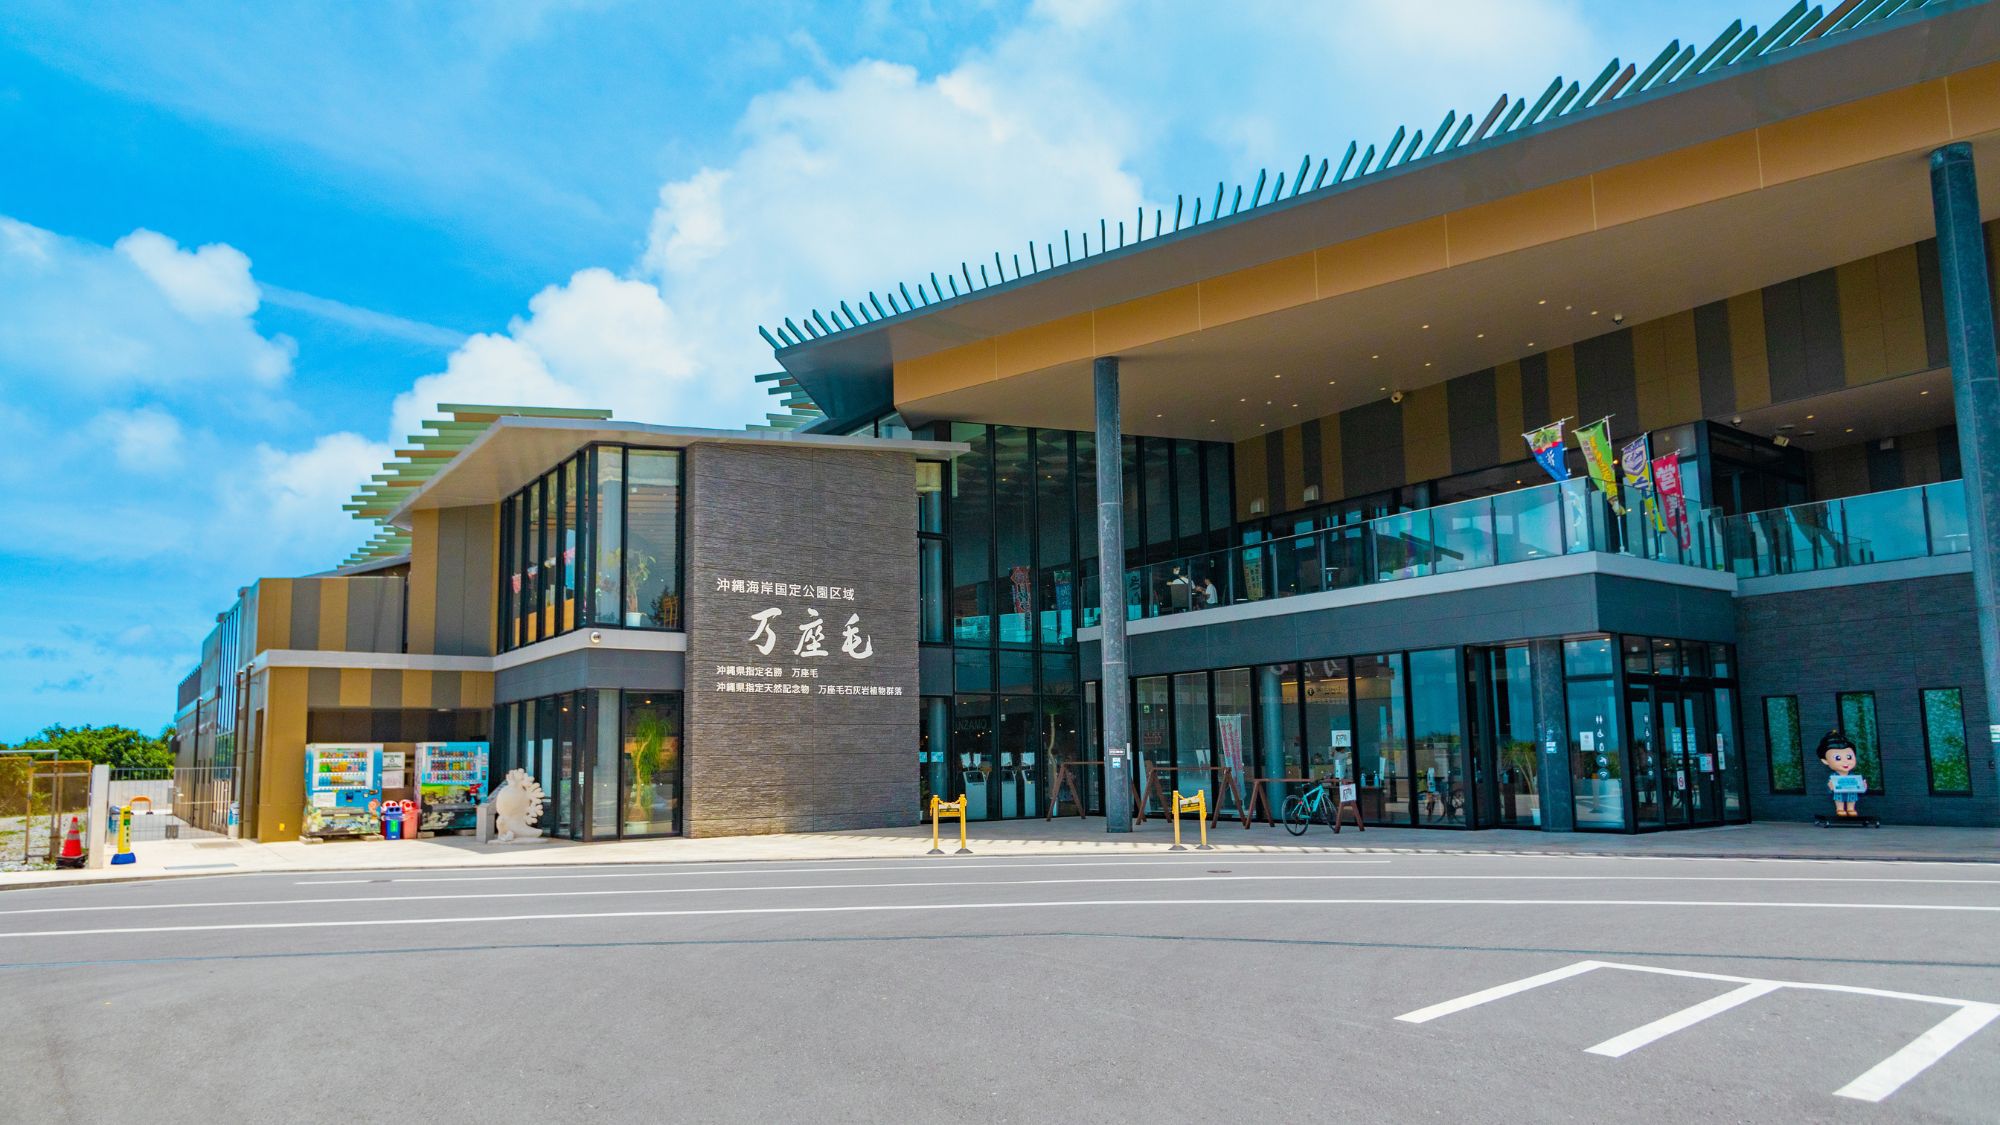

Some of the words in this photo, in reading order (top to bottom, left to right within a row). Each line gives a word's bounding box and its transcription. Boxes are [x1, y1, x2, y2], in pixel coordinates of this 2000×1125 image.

[716, 577, 855, 601] 沖縄海岸国定公園区域
[749, 607, 873, 659] 万座毛
[716, 665, 783, 677] 沖縄県指定名勝
[791, 667, 819, 678] 万座毛
[716, 681, 810, 694] 沖縄県指定天然記念物
